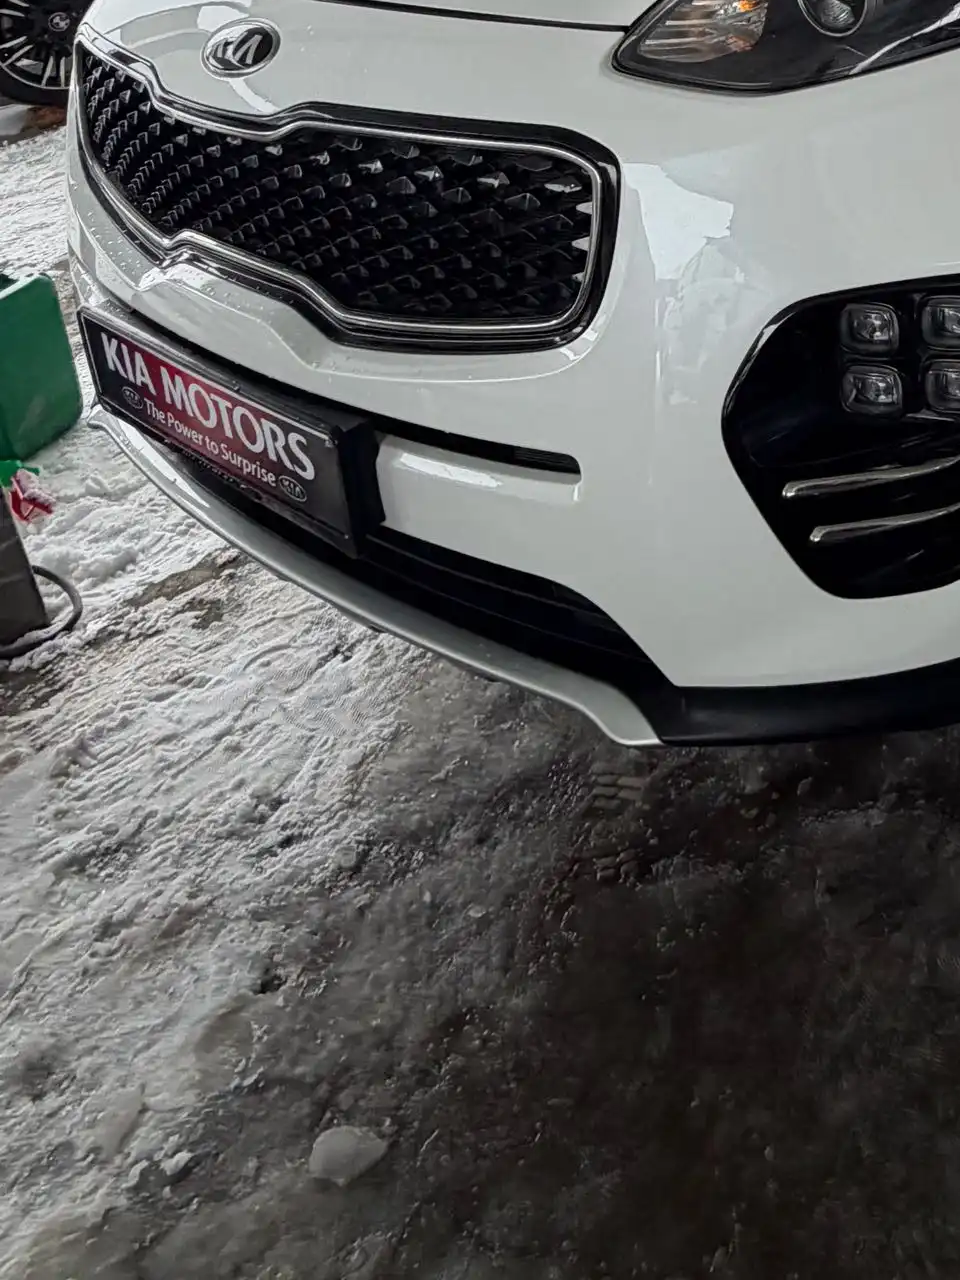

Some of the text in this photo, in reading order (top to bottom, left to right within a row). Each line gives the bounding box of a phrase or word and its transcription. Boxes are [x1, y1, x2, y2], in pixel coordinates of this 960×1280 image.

[100, 331, 316, 481] KIA MOTORS
[143, 397, 277, 487] The Power to Surprise
